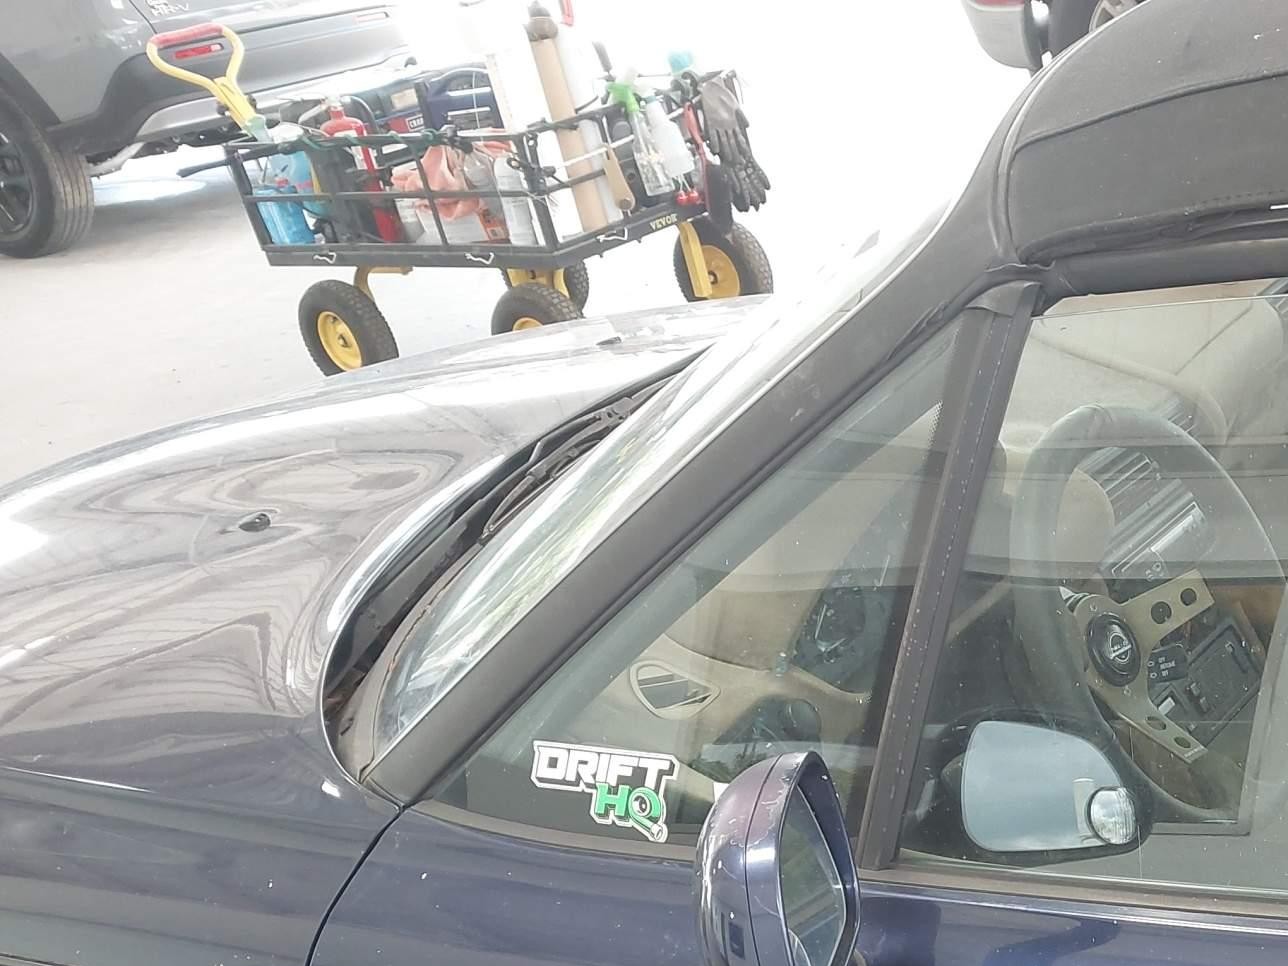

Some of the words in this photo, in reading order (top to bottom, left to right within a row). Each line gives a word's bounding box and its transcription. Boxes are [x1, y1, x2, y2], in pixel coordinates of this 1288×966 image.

[151, 3, 190, 16] HR-V
[649, 213, 678, 231] VEVOR
[535, 745, 672, 792] DRIFT
[595, 782, 666, 842] HQ
